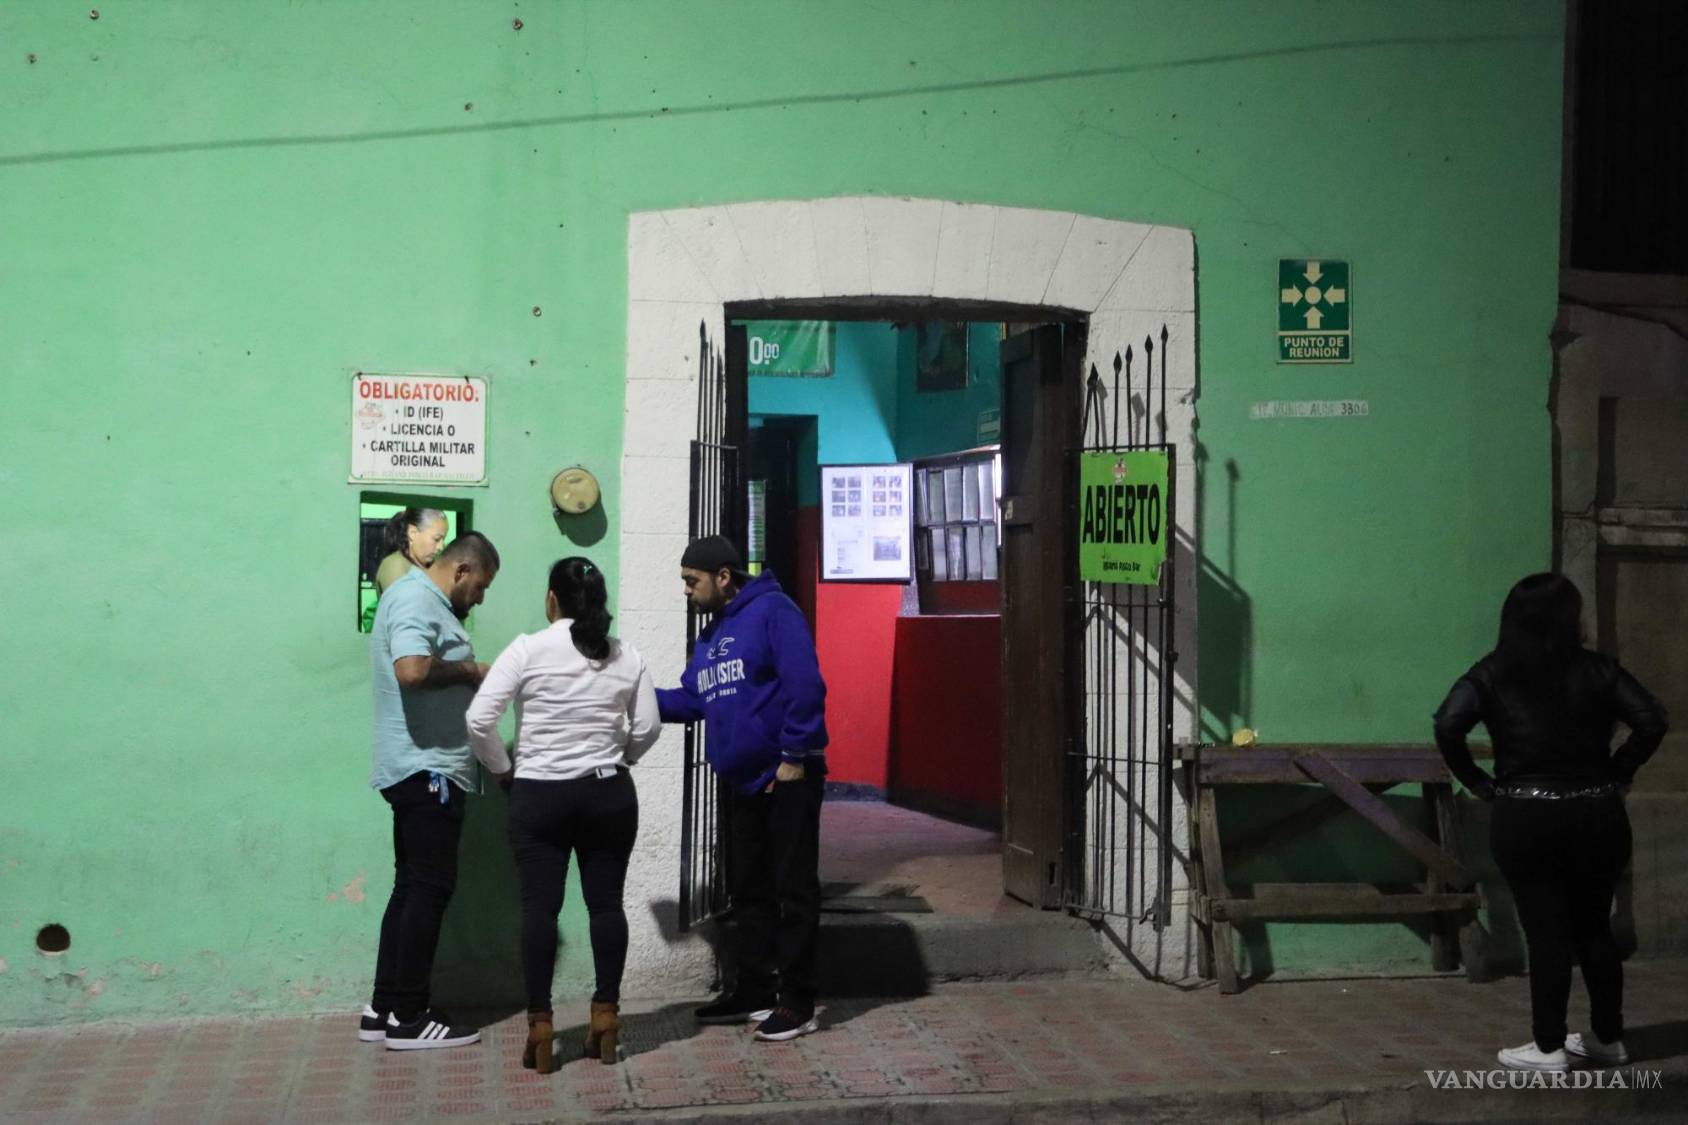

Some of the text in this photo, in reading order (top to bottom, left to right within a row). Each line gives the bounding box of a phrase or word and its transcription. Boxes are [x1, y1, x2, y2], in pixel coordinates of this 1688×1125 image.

[1284, 336, 1344, 347] PUNTO DE
[403, 406, 444, 420] ID (IFE)
[391, 423, 455, 437] LICENCIA O
[370, 440, 475, 454] CARTILLA MILITAR
[390, 454, 446, 468] ORIGINAL
[1082, 484, 1160, 544] ABIERTO
